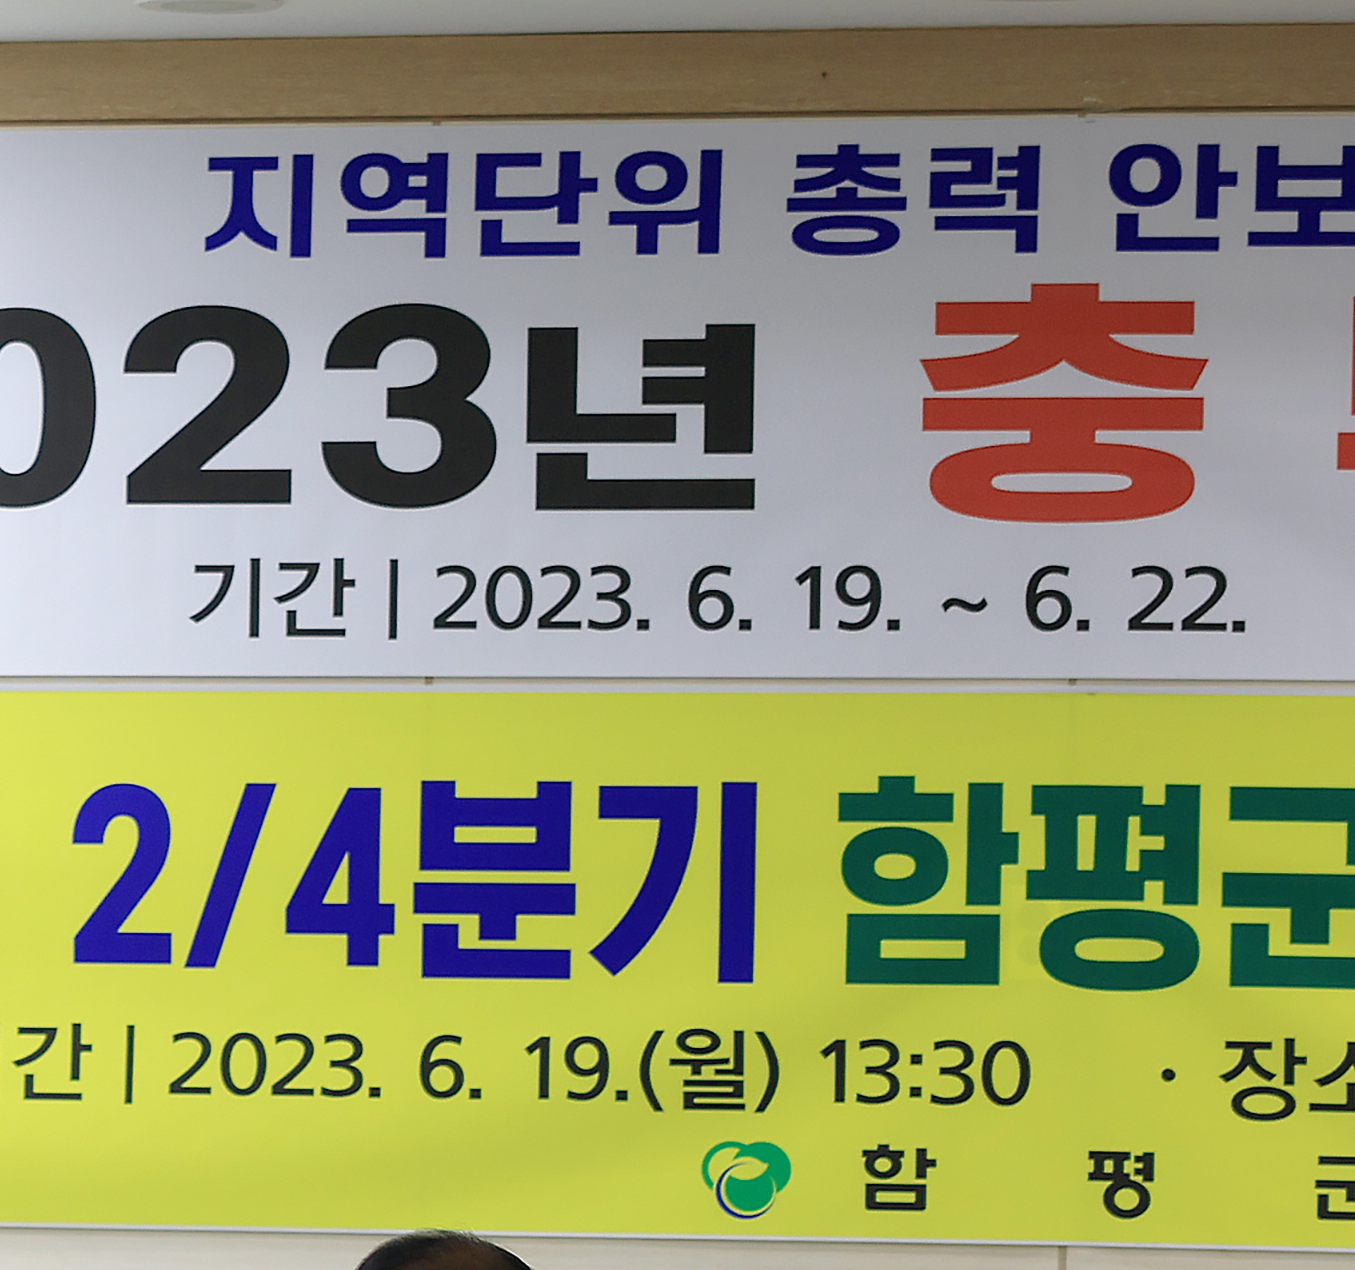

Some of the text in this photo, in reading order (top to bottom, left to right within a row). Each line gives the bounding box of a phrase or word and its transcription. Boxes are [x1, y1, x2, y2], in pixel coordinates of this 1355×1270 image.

[205, 149, 722, 258] 지역단위
[787, 144, 1040, 255] 총력
[190, 558, 355, 638] 기간
[434, 565, 649, 630] 2023.
[689, 565, 751, 630] 6.
[796, 565, 900, 631] 19.
[1026, 565, 1089, 631] 6.
[1128, 566, 1245, 632] 22.
[73, 781, 757, 983] 2/4분기
[169, 1032, 381, 1098] 2023.
[420, 1035, 481, 1099] 6.
[820, 1039, 1030, 1106] 13:30
